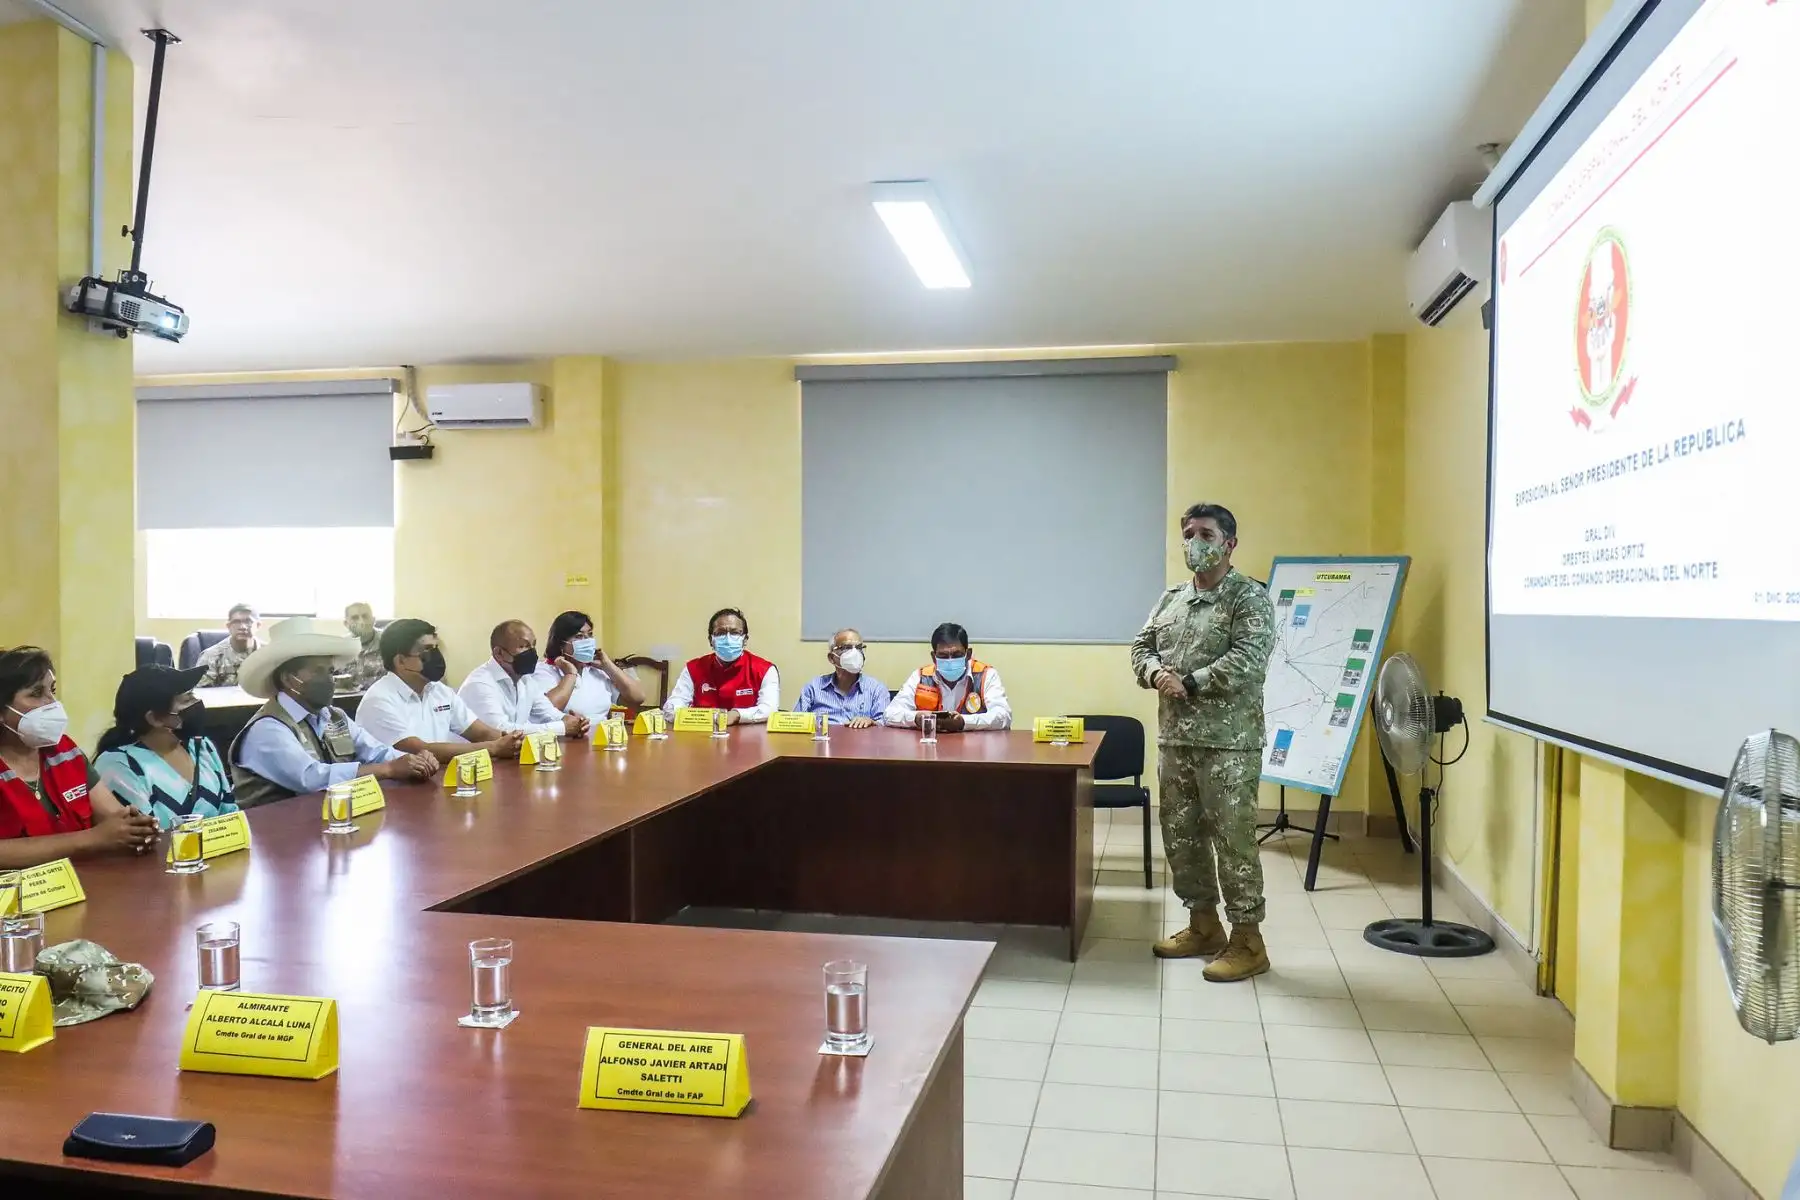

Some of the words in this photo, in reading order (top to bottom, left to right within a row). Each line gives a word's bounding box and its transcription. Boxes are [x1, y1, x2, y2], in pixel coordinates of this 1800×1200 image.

[1550, 481, 1559, 496] AL
[1586, 453, 1639, 484] PRESIDENTE
[1641, 448, 1654, 469] DE
[1657, 443, 1670, 463] LA
[1674, 417, 1746, 457] REPUBLICA
[1621, 542, 1645, 560] ORTIZ
[1605, 566, 1660, 584] OPERACIONAL
[1663, 564, 1680, 582] DEL
[1683, 561, 1718, 581] NORTE
[0, 984, 25, 994] RCITO
[238, 1002, 290, 1013] ALMIRANTE
[206, 1014, 247, 1025] ALBERTO
[286, 1020, 311, 1030] LUNA
[215, 1029, 239, 1038] Cmdte
[240, 1031, 256, 1040] Gral
[276, 1034, 294, 1042] MGP
[618, 1041, 664, 1052] GENERAL
[667, 1043, 687, 1053] DEL
[689, 1045, 713, 1054] AIRE
[600, 1056, 647, 1067] ALFONSO
[650, 1059, 687, 1069] JAVIER
[689, 1061, 727, 1071] ARTADI
[640, 1073, 683, 1084] SALETTI
[617, 1087, 643, 1096] Cmdte
[645, 1089, 663, 1098] Gral
[665, 1090, 675, 1098] de
[677, 1091, 685, 1099] la
[687, 1092, 704, 1100] FAP
